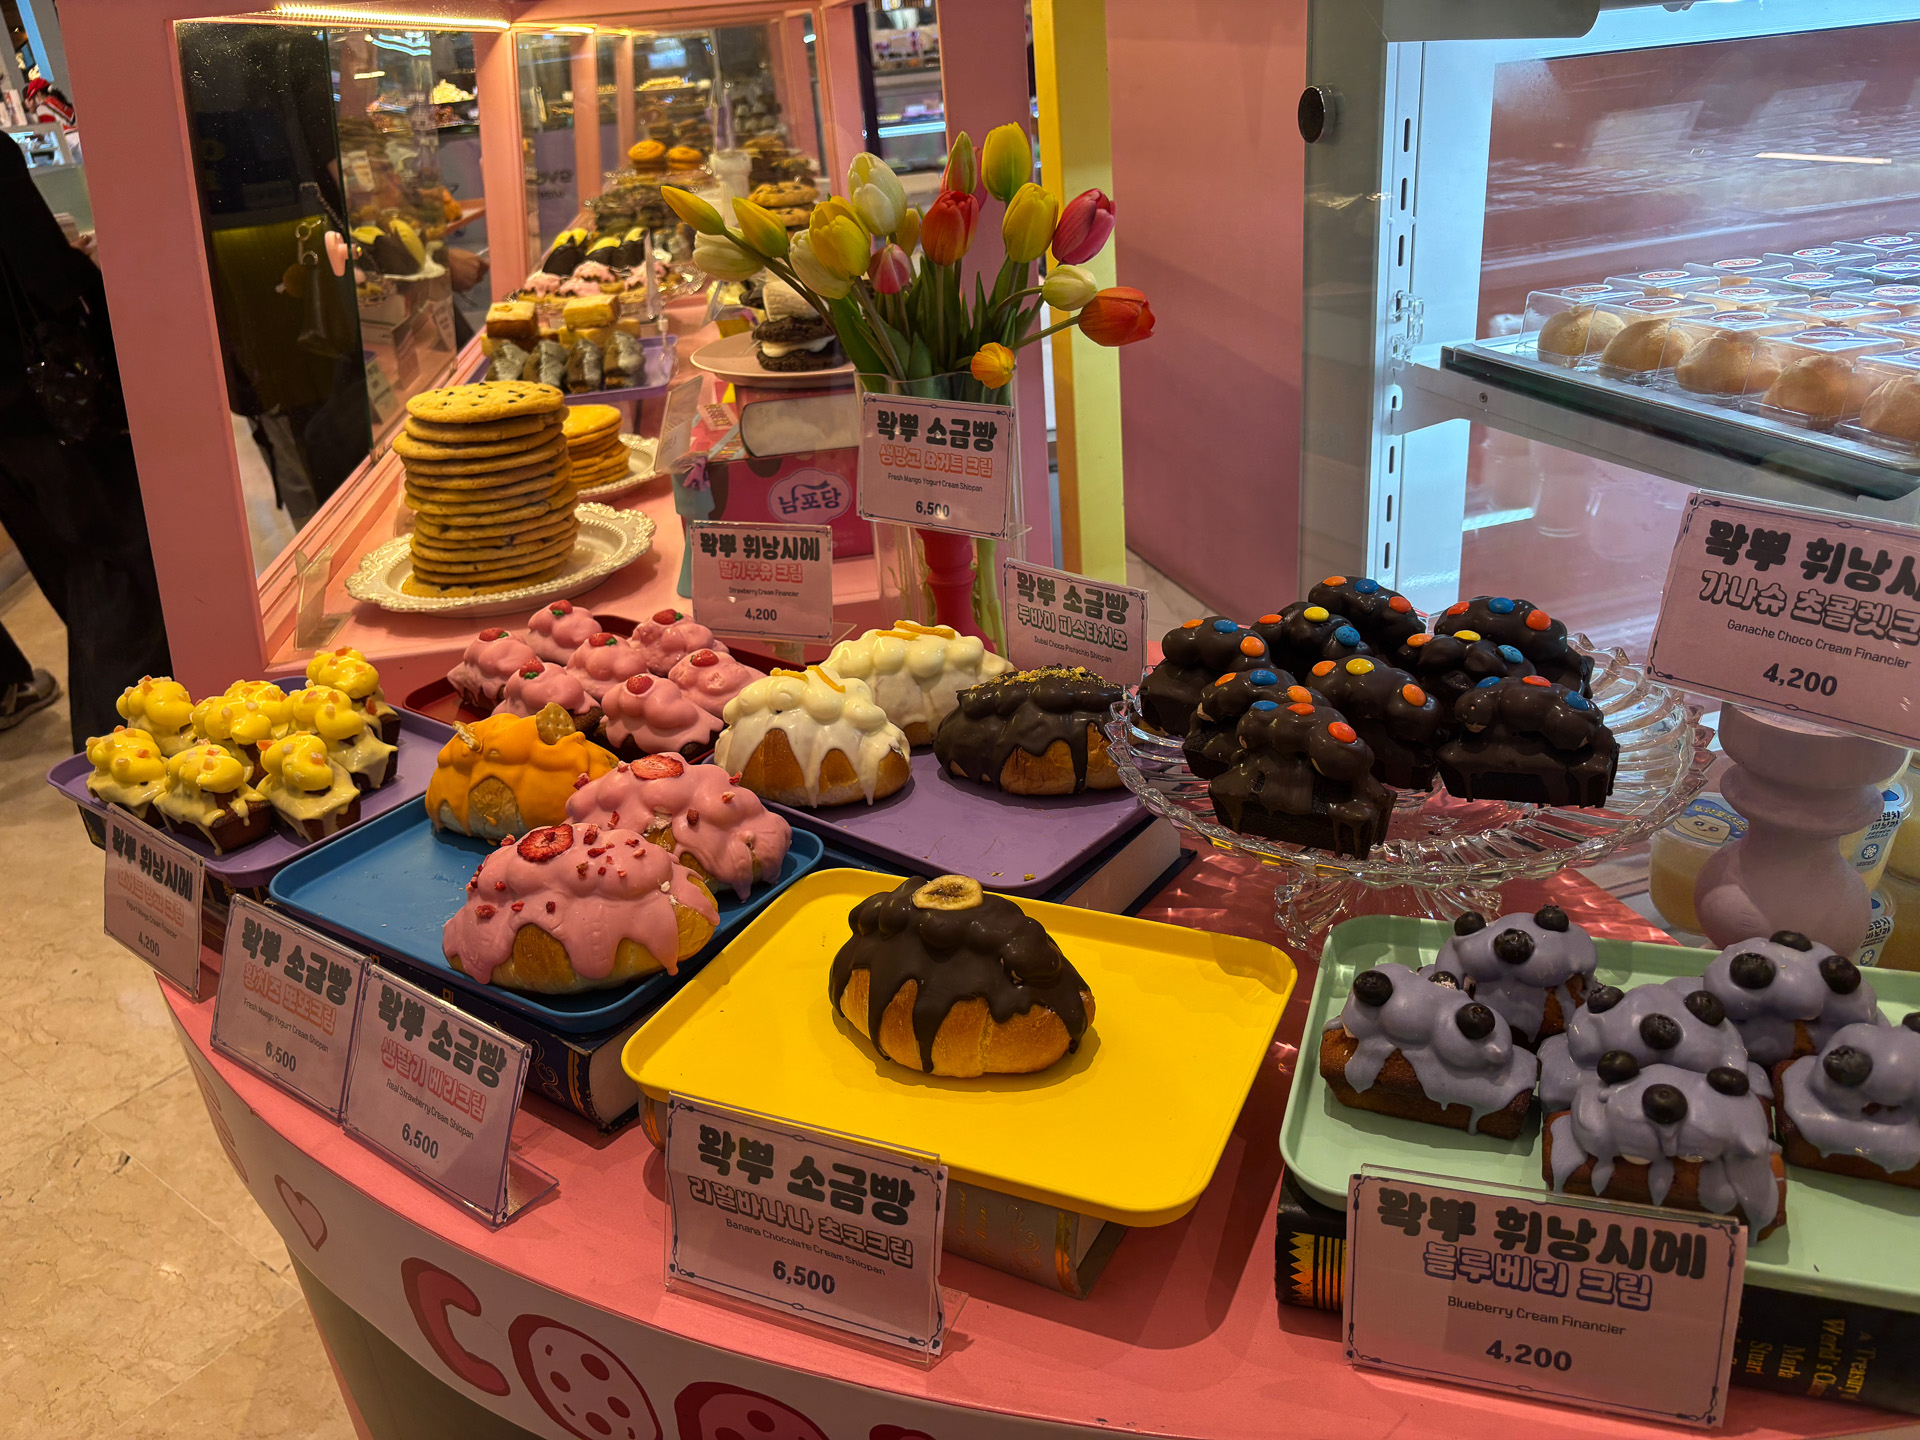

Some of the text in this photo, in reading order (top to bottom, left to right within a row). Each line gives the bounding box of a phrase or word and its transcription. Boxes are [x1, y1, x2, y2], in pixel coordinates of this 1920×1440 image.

[877, 410, 997, 452] 왁뿌 소금빵
[879, 444, 993, 478] 생망고 요거트 크림
[888, 473, 903, 481] Fresh
[904, 475, 921, 485] Mango
[922, 477, 941, 487] Yogurt
[942, 480, 959, 489] Cream
[778, 480, 842, 515] 남포당
[916, 500, 950, 517] 6,500
[700, 532, 821, 561] 왁뿌 휘낭시에
[1705, 519, 1791, 571] 왁뿌
[719, 560, 803, 583] 딸기우유 크림
[1699, 569, 1787, 617] 가나슈
[745, 608, 777, 621] 4,200
[1017, 571, 1129, 624] 왁뿌 소금빵
[1017, 603, 1128, 651] 두바이 피스타치오
[1048, 639, 1065, 651] Choco
[1727, 619, 1912, 669] Ganache Choco Cream Financier
[1763, 663, 1838, 696] 4,200
[113, 825, 193, 902] 왁뿌 휘낭시에
[164, 895, 185, 928] 크림
[139, 931, 160, 957] 4,200
[242, 917, 352, 1006] 왁뿌 소금빵
[243, 961, 282, 1005] 황치즈
[244, 997, 257, 1012] Fresh
[258, 1006, 274, 1021] Mango
[275, 1015, 292, 1031] Yogurt
[292, 1024, 309, 1041] Cream
[379, 984, 507, 1088] 왁뿌 소금빵
[265, 1041, 296, 1072] 6,500
[381, 1036, 486, 1123] 생딸기 베리크림
[386, 1078, 400, 1093] Real
[400, 1086, 432, 1115] Strawberry
[431, 1106, 449, 1125] Cream
[401, 1122, 439, 1159] 6,500
[698, 1124, 774, 1185] 왁뿌
[787, 1155, 915, 1226] 소금빵
[687, 1175, 814, 1235] 리얼바나나
[818, 1216, 914, 1269] 초코크림
[726, 1218, 761, 1236] Banana
[763, 1229, 812, 1251] Chocolate
[813, 1244, 844, 1262] Cream
[1377, 1187, 1707, 1279] 왁뿌 휘낭시에
[773, 1260, 836, 1294] 6,500
[1423, 1241, 1653, 1312] 블루베리 크림
[1447, 1296, 1627, 1335] Blueberry Cream Financier
[1485, 1340, 1572, 1372] 4,200
[1745, 1340, 1773, 1375] Stuart
[1816, 1318, 1846, 1372] World's
[1838, 1347, 1877, 1395] Treasury
